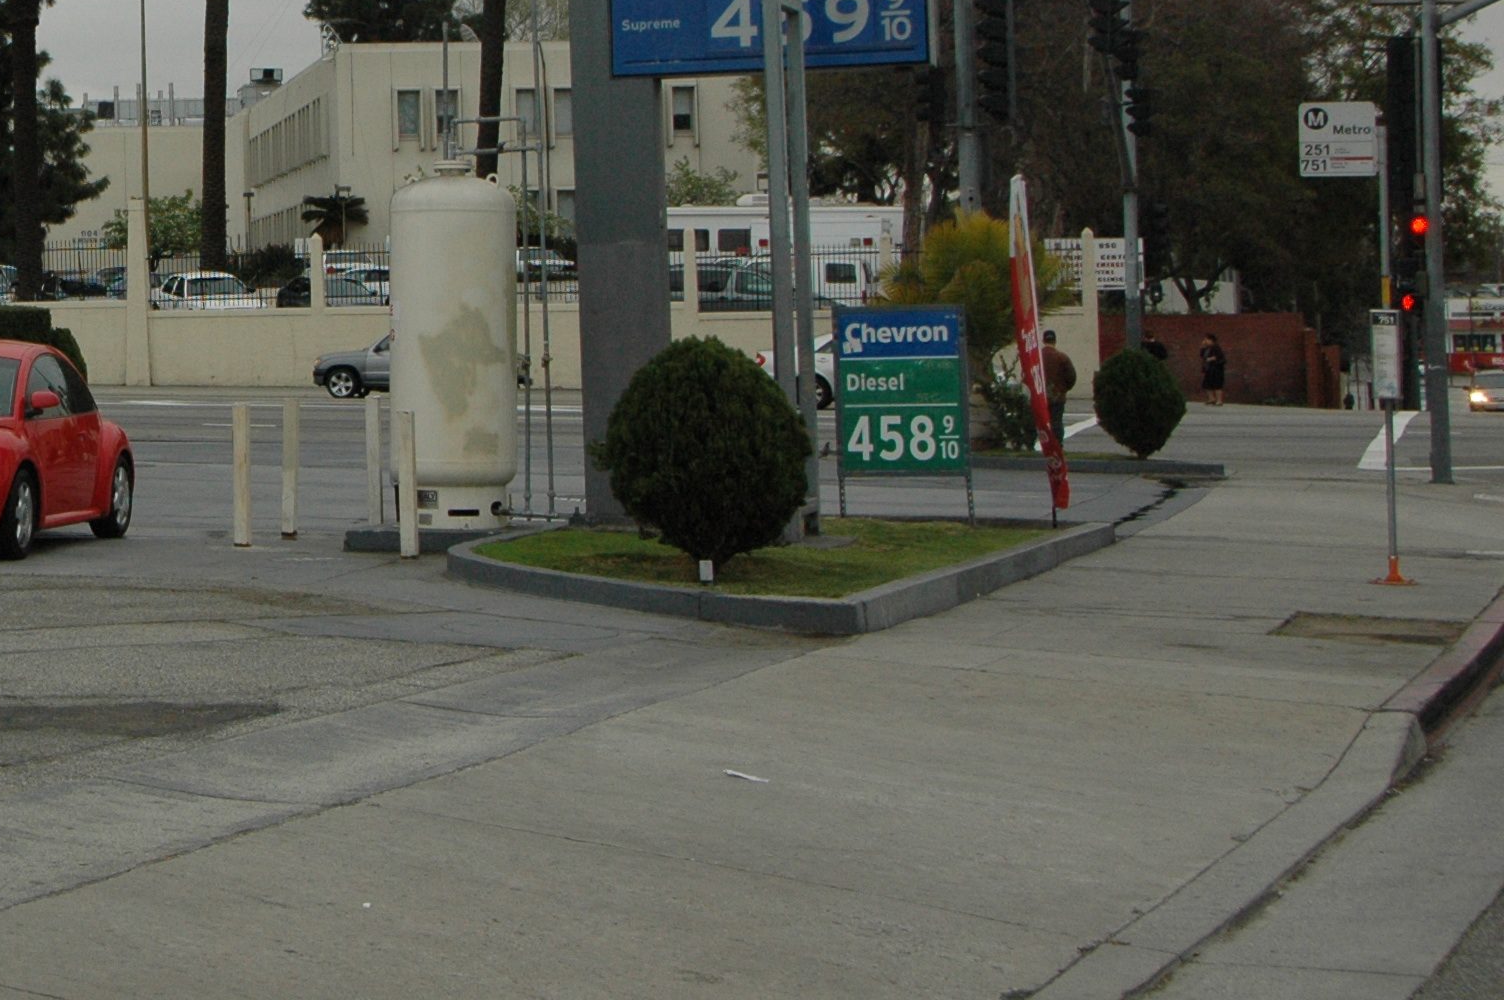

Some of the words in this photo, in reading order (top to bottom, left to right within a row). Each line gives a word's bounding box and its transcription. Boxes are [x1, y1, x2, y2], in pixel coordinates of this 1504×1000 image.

[622, 18, 680, 32] Supreme
[1333, 124, 1372, 135] Metro
[1305, 143, 1330, 156] 251
[1300, 159, 1328, 172] 751
[1377, 315, 1395, 325] 751
[845, 322, 949, 344] Chevron
[846, 372, 905, 391] Diesel
[848, 415, 936, 461] 458
